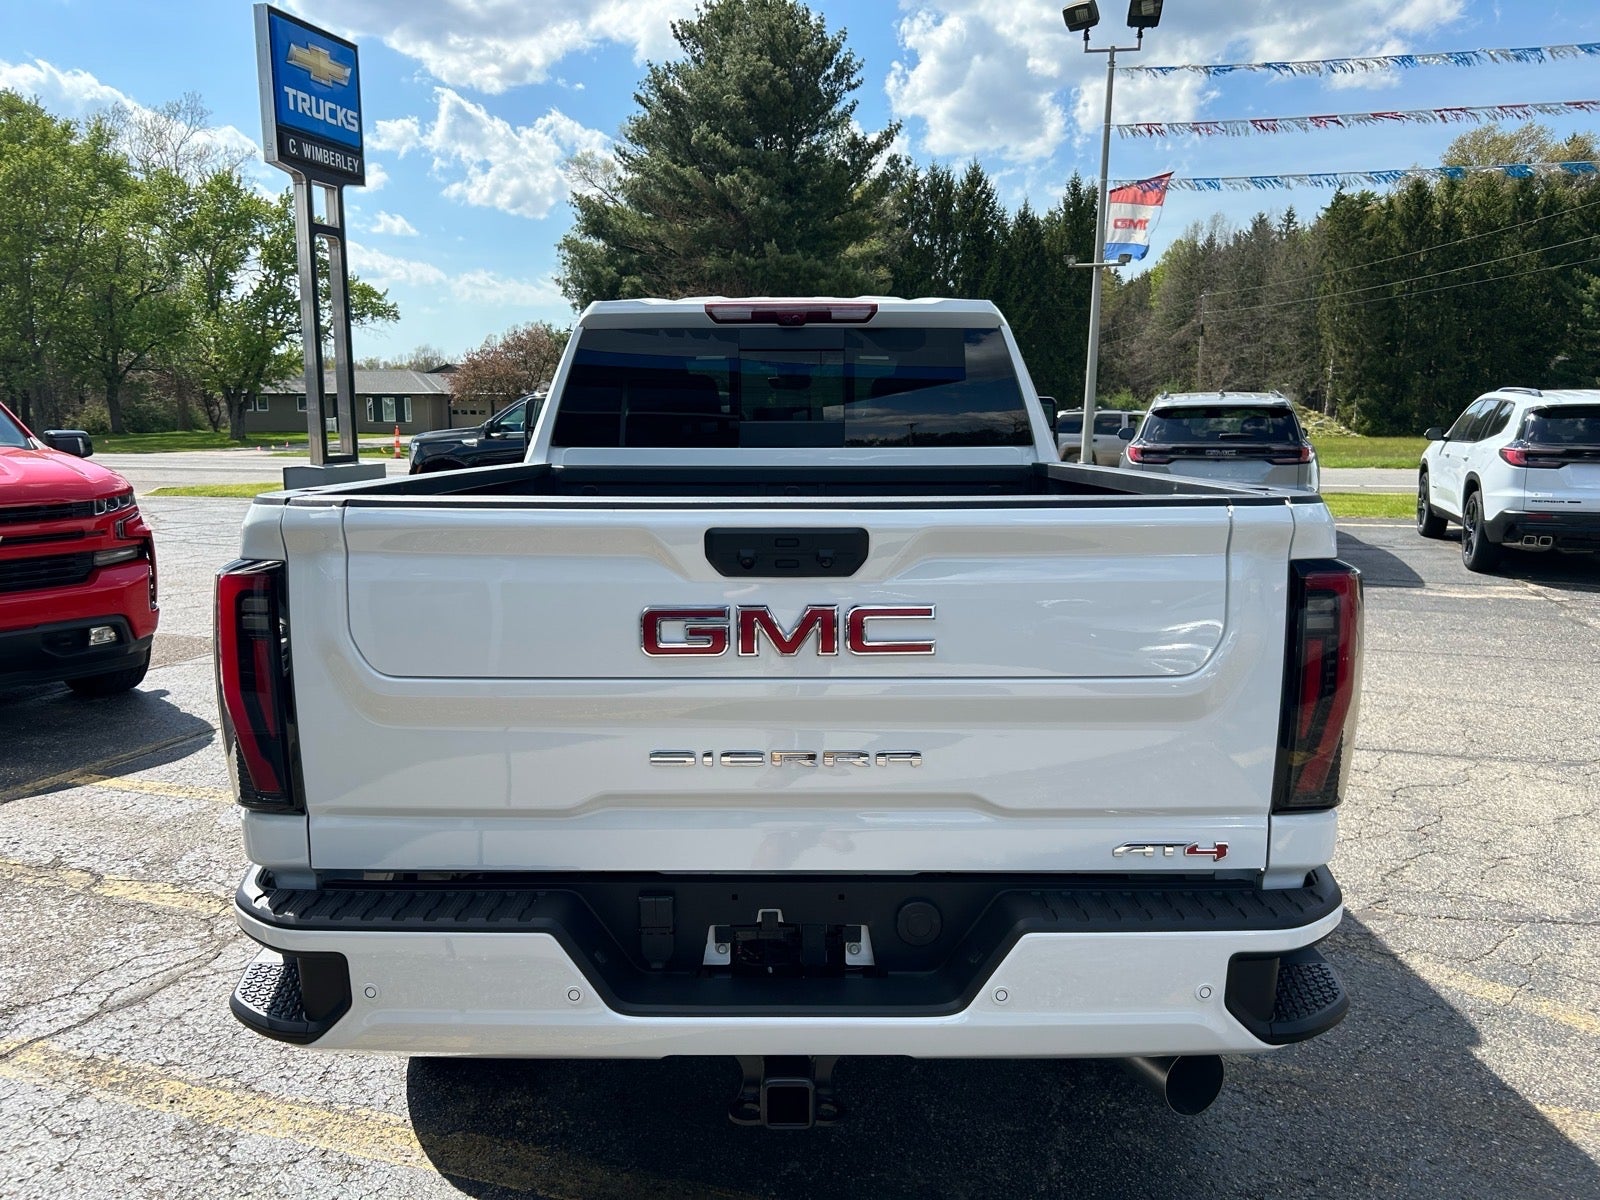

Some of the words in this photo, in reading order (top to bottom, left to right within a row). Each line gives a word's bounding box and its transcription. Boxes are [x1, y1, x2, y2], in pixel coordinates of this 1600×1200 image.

[284, 85, 358, 132] TRUCKS
[289, 138, 298, 156] C.
[302, 142, 359, 173] WIMBERLEY
[640, 604, 936, 657] GMC
[650, 750, 923, 768] SIERRA
[1112, 841, 1229, 862] AT4
